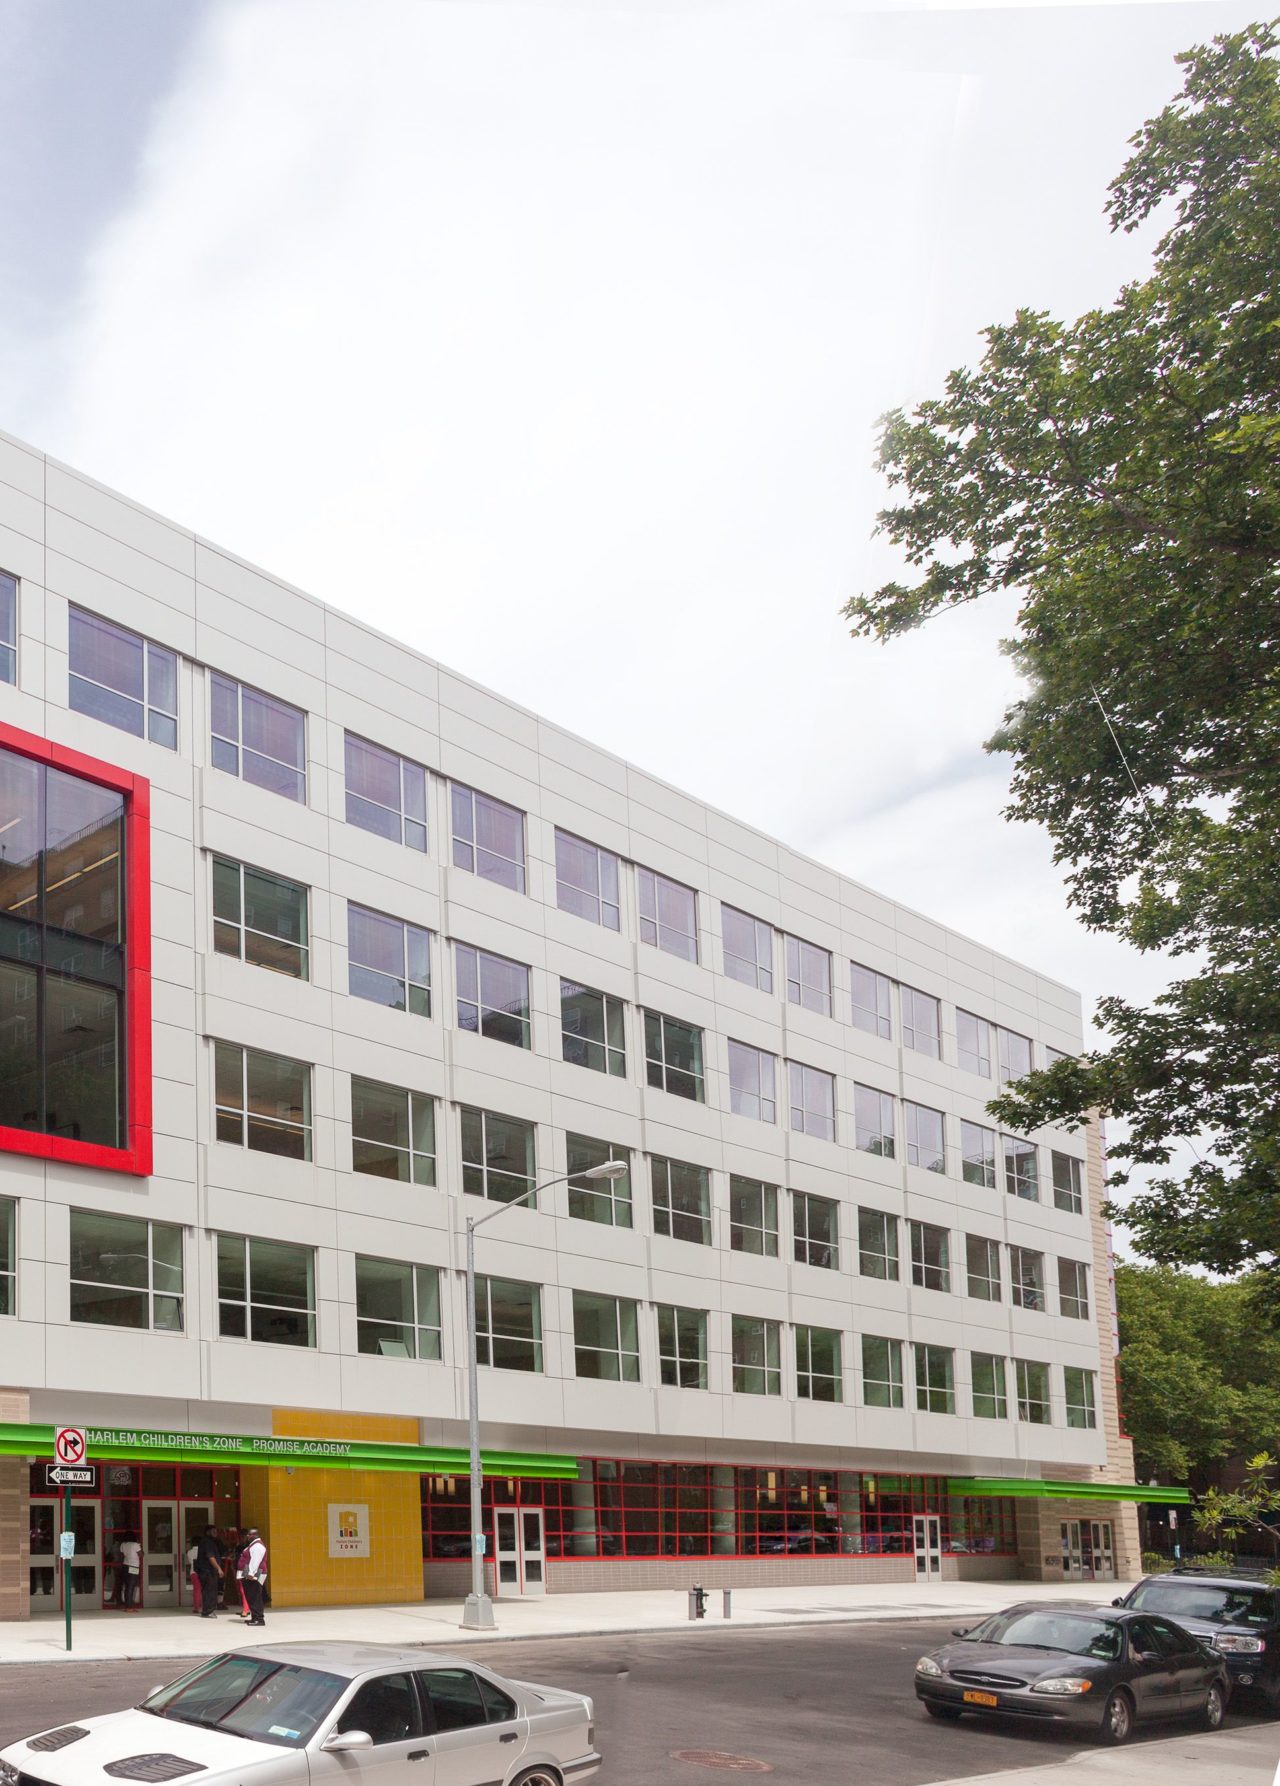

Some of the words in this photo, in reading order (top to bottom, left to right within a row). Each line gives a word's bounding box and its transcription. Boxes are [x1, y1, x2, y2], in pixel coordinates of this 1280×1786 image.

[86, 1430, 137, 1444] HARLEM
[141, 1433, 210, 1447] CHILDREN'S
[213, 1437, 243, 1448] ZONE
[253, 1439, 300, 1451] PROMISE
[303, 1442, 351, 1454] ACADEMY
[55, 1471, 70, 1480] ONE
[72, 1472, 88, 1480] WAY
